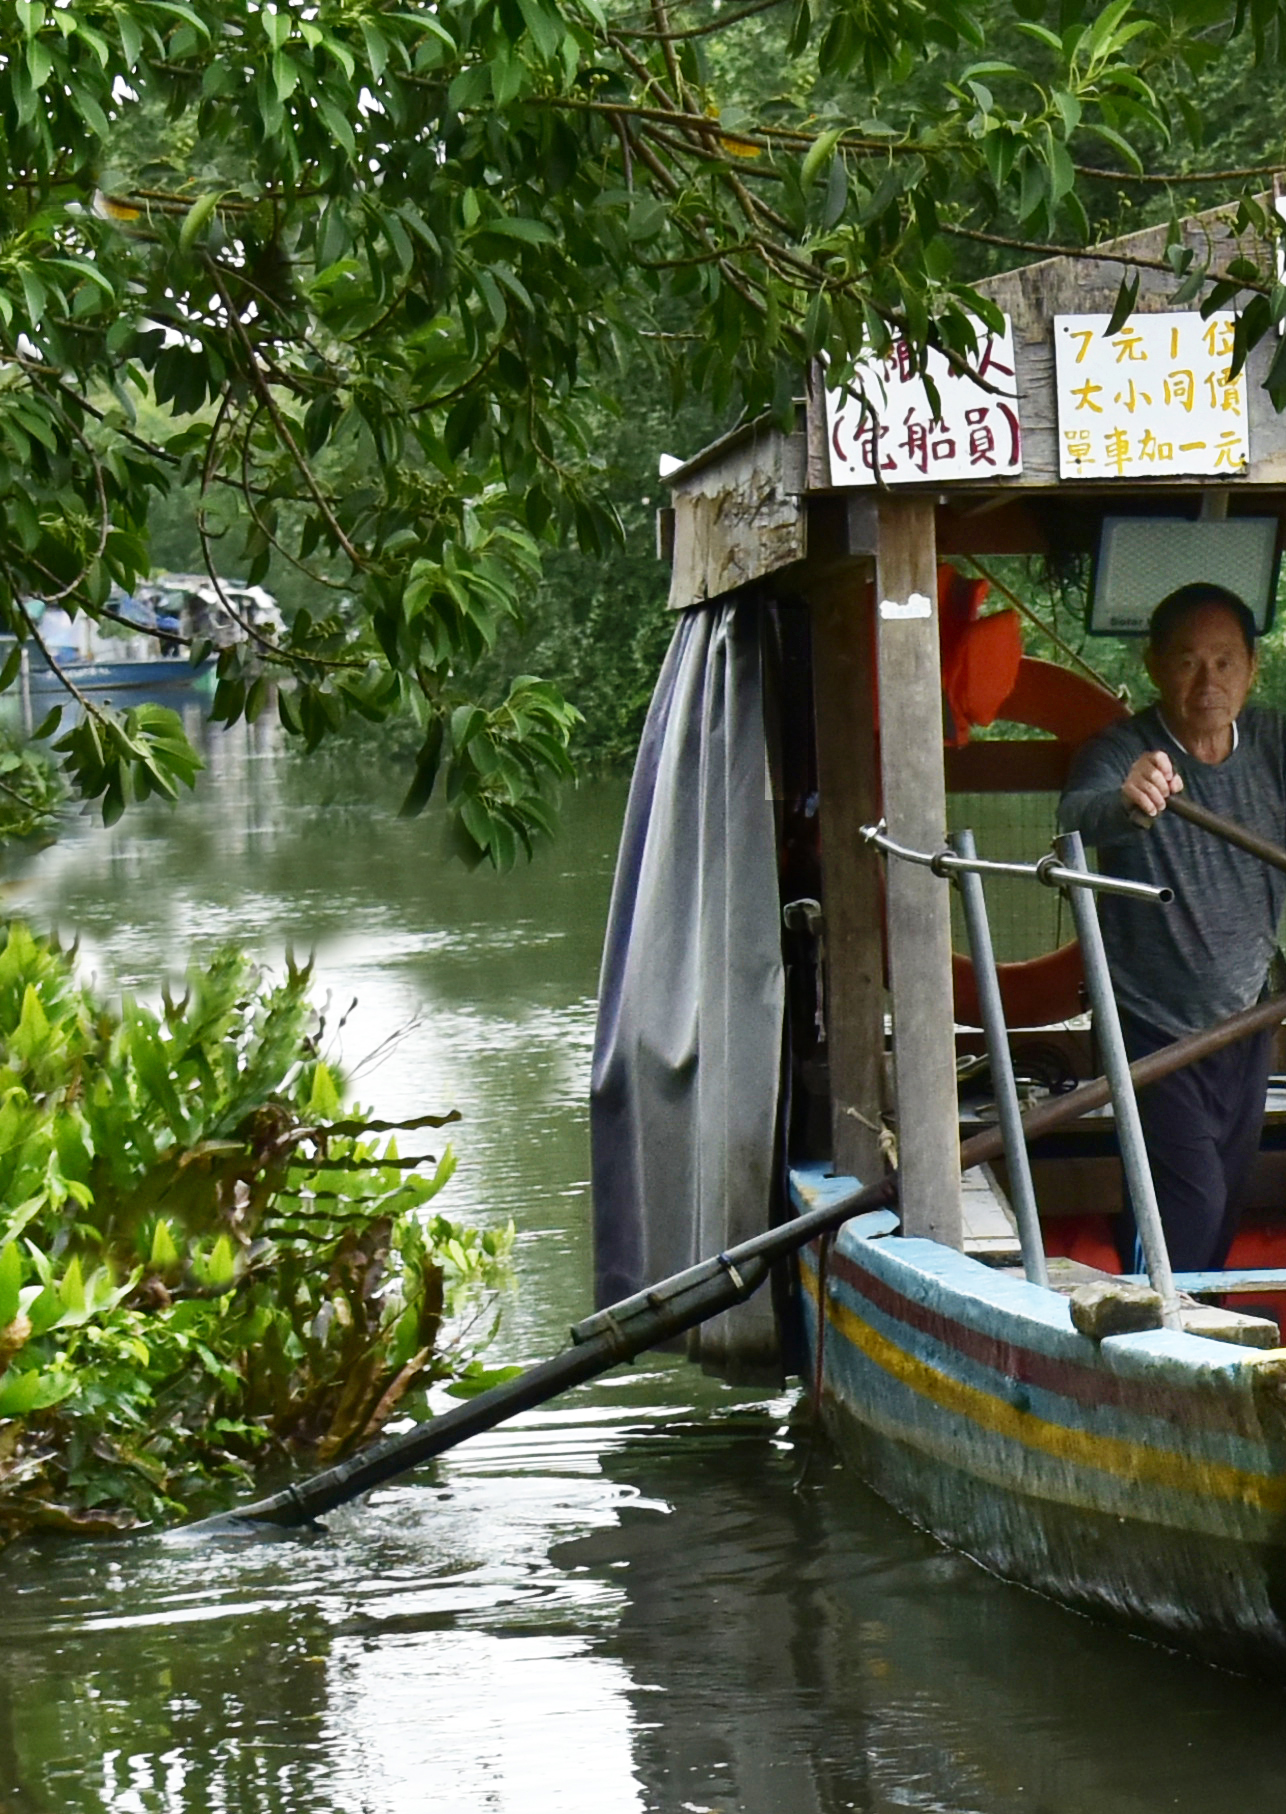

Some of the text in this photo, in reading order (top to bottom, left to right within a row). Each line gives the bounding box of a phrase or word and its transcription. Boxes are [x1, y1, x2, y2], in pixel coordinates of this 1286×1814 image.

[1070, 367, 1243, 416] 大小同價
[1064, 426, 1246, 475] 單車加一元
